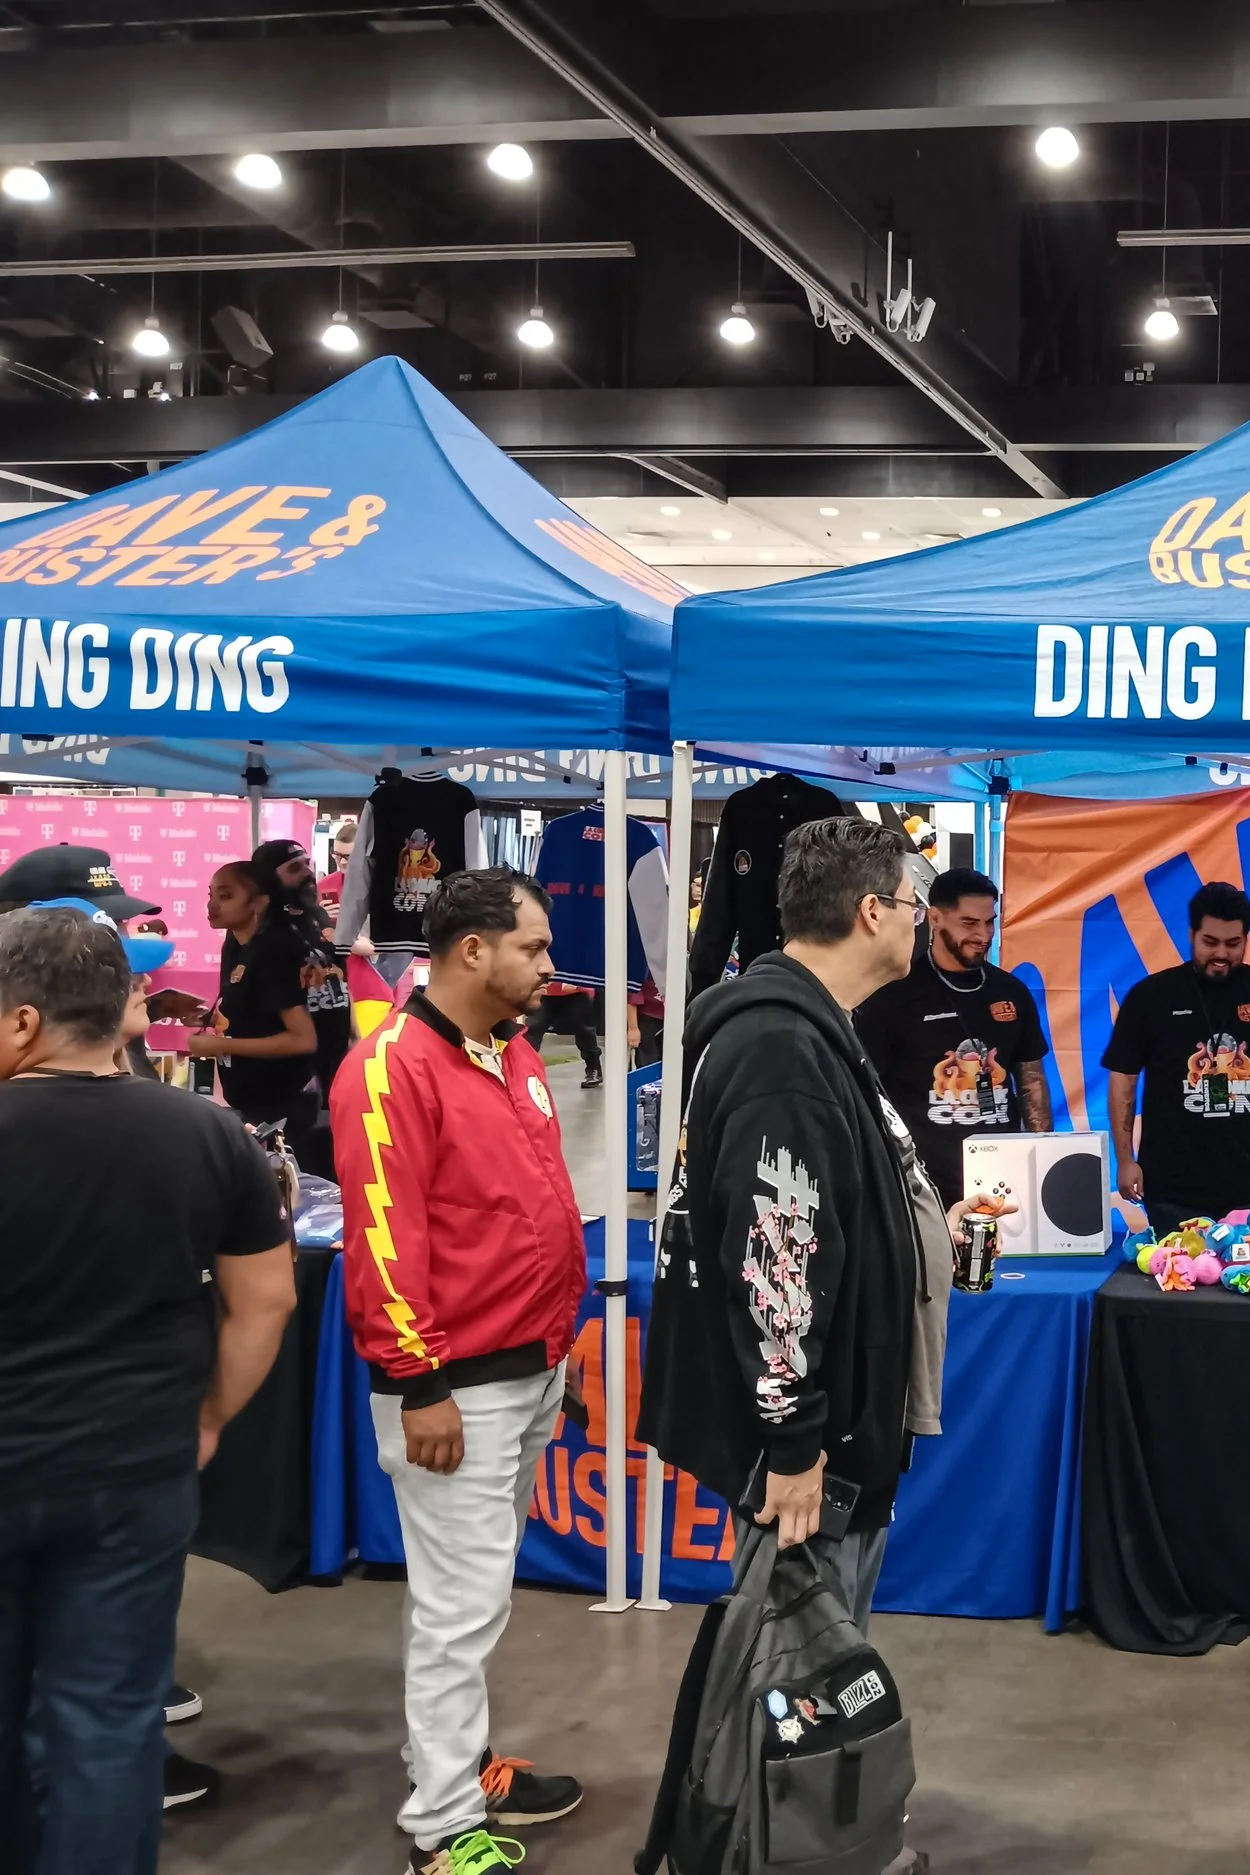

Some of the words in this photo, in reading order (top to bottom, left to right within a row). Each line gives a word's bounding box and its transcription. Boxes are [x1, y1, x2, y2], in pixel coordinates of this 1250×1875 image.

[309, 494, 387, 547] &
[0, 618, 110, 710] ING
[129, 628, 295, 714] DING
[1033, 624, 1218, 720] DING
[528, 1446, 736, 1561] USTE
[840, 1678, 874, 1716] BLIZZ
[867, 1674, 882, 1697] CON
